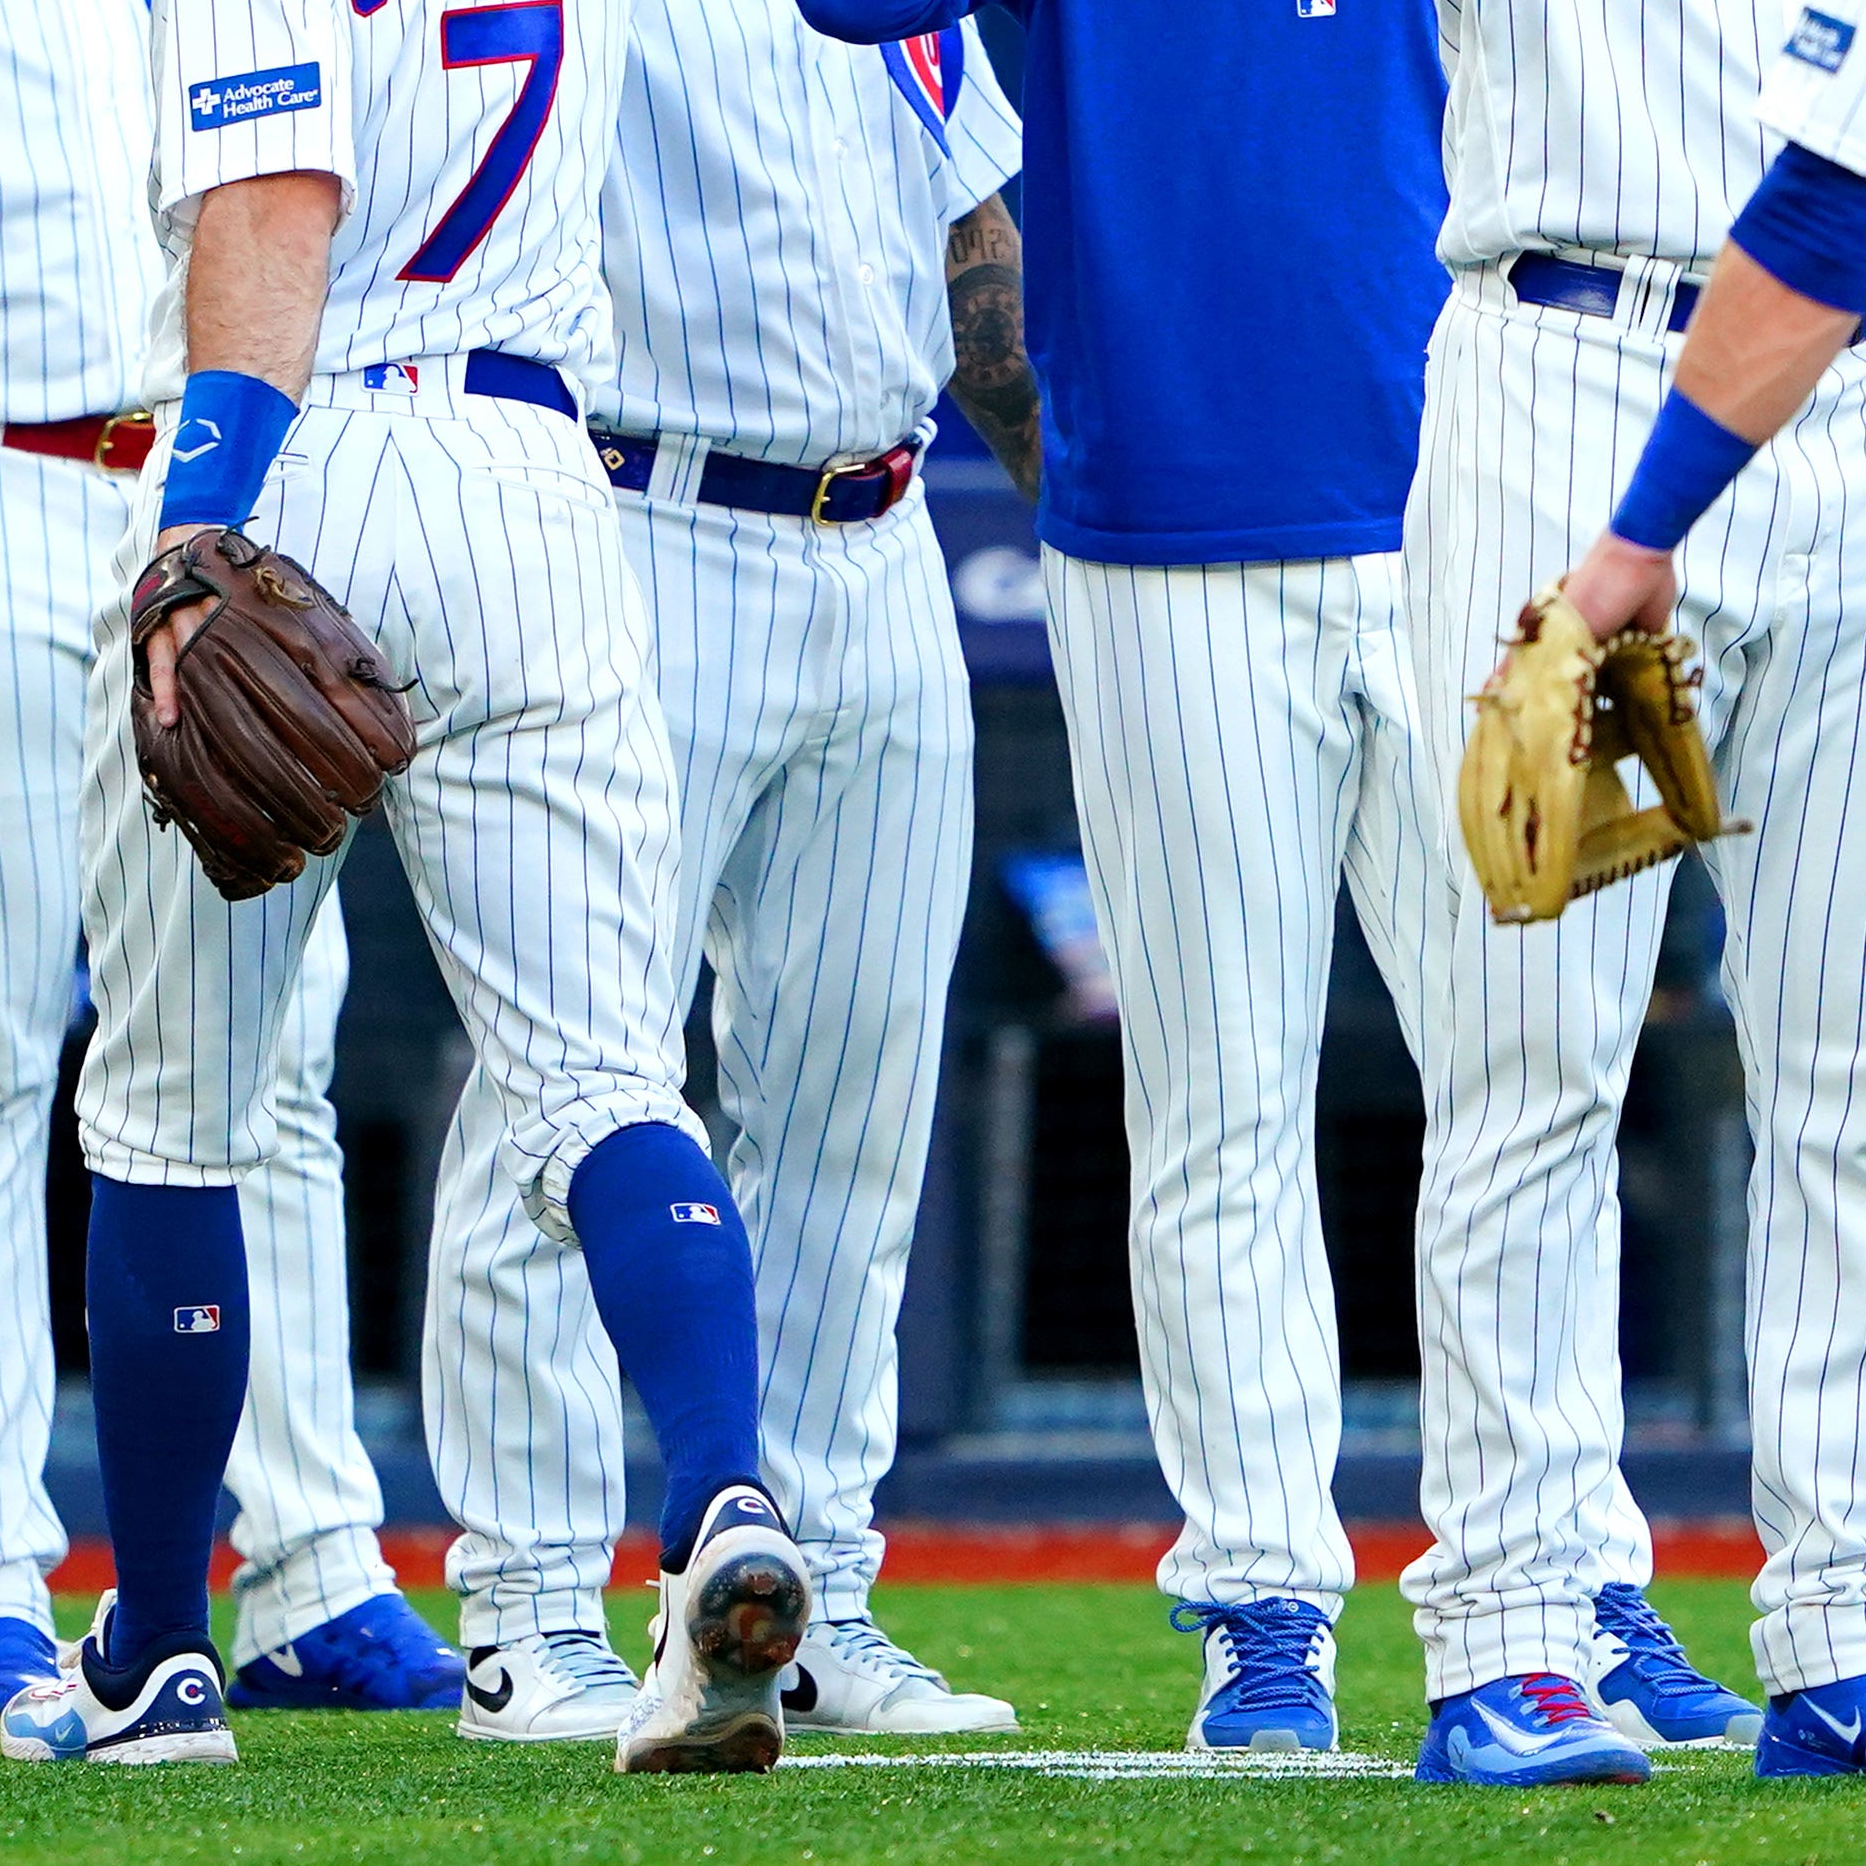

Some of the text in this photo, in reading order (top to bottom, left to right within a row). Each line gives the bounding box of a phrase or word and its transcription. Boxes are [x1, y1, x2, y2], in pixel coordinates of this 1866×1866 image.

[223, 79, 294, 104] Advocate
[223, 90, 315, 119] Health Care
[736, 1497, 767, 1515] C
[177, 1677, 206, 1706] C
